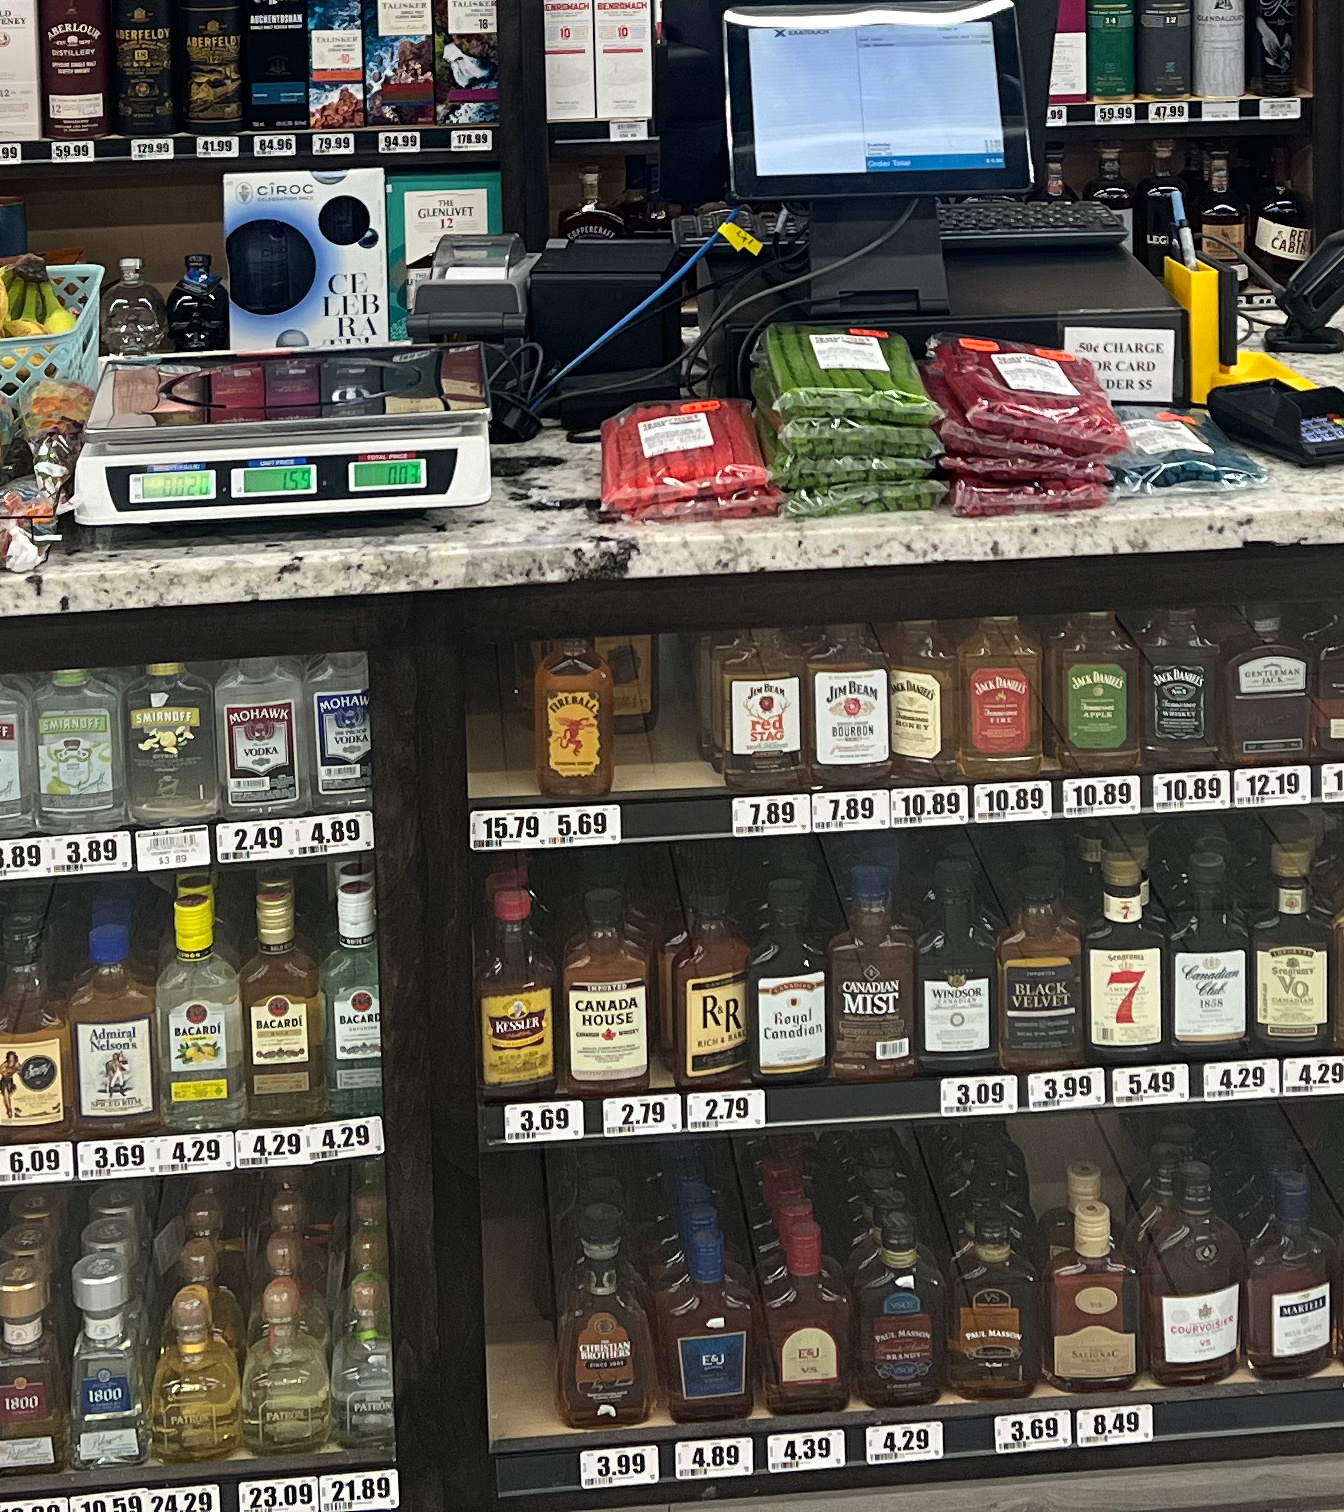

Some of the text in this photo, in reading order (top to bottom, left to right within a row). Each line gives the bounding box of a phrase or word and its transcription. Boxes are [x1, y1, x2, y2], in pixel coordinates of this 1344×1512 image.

[116, 28, 170, 41] ABERFELDY
[1099, 107, 1133, 120] 59.99
[867, 159, 911, 168] Order Total
[257, 184, 314, 196] CÎROC
[418, 206, 474, 219] GLENLIVET
[328, 274, 368, 294] CE
[323, 295, 380, 316] LEB
[338, 317, 378, 337] RA
[1104, 343, 1164, 353] CHARGE
[1116, 361, 1156, 371] CARD
[1138, 379, 1152, 390] $5
[826, 681, 878, 702] JIM BEAM
[42, 717, 104, 732] SMIRNOFF
[229, 708, 290, 725] MOHAWK
[831, 725, 874, 738] BOURBON
[1246, 772, 1300, 796] 12.19
[829, 797, 875, 821] 7.89
[984, 787, 1044, 812] 10.89
[234, 825, 284, 851] 2.49
[311, 818, 360, 843] 4.89
[483, 816, 540, 840] 15.79
[842, 980, 899, 993] CANADIAN
[1014, 982, 1067, 998] BLACK
[575, 997, 638, 1012] CANADA
[843, 993, 900, 1014] MIST
[1012, 994, 1069, 1009] VELVET
[1108, 971, 1145, 1023] 7
[582, 1012, 634, 1025] HOUSE
[89, 1027, 136, 1042] Admiral
[90, 1039, 137, 1052] Nelson's
[1129, 1071, 1175, 1095] 5.49
[956, 1082, 1005, 1106] 3.09
[520, 1108, 569, 1132] 3.69
[253, 1133, 301, 1158] 4.29
[579, 1340, 631, 1359] CHRISTIAN
[88, 1386, 122, 1402] 1800
[1011, 1417, 1059, 1441] 3.69
[1093, 1412, 1140, 1435] 8.49
[783, 1438, 831, 1462] 4.39
[883, 1429, 929, 1452] 4.29
[597, 1455, 646, 1478] 3.99
[249, 1485, 314, 1508] 23.09
[331, 1477, 391, 1501] 21.89
